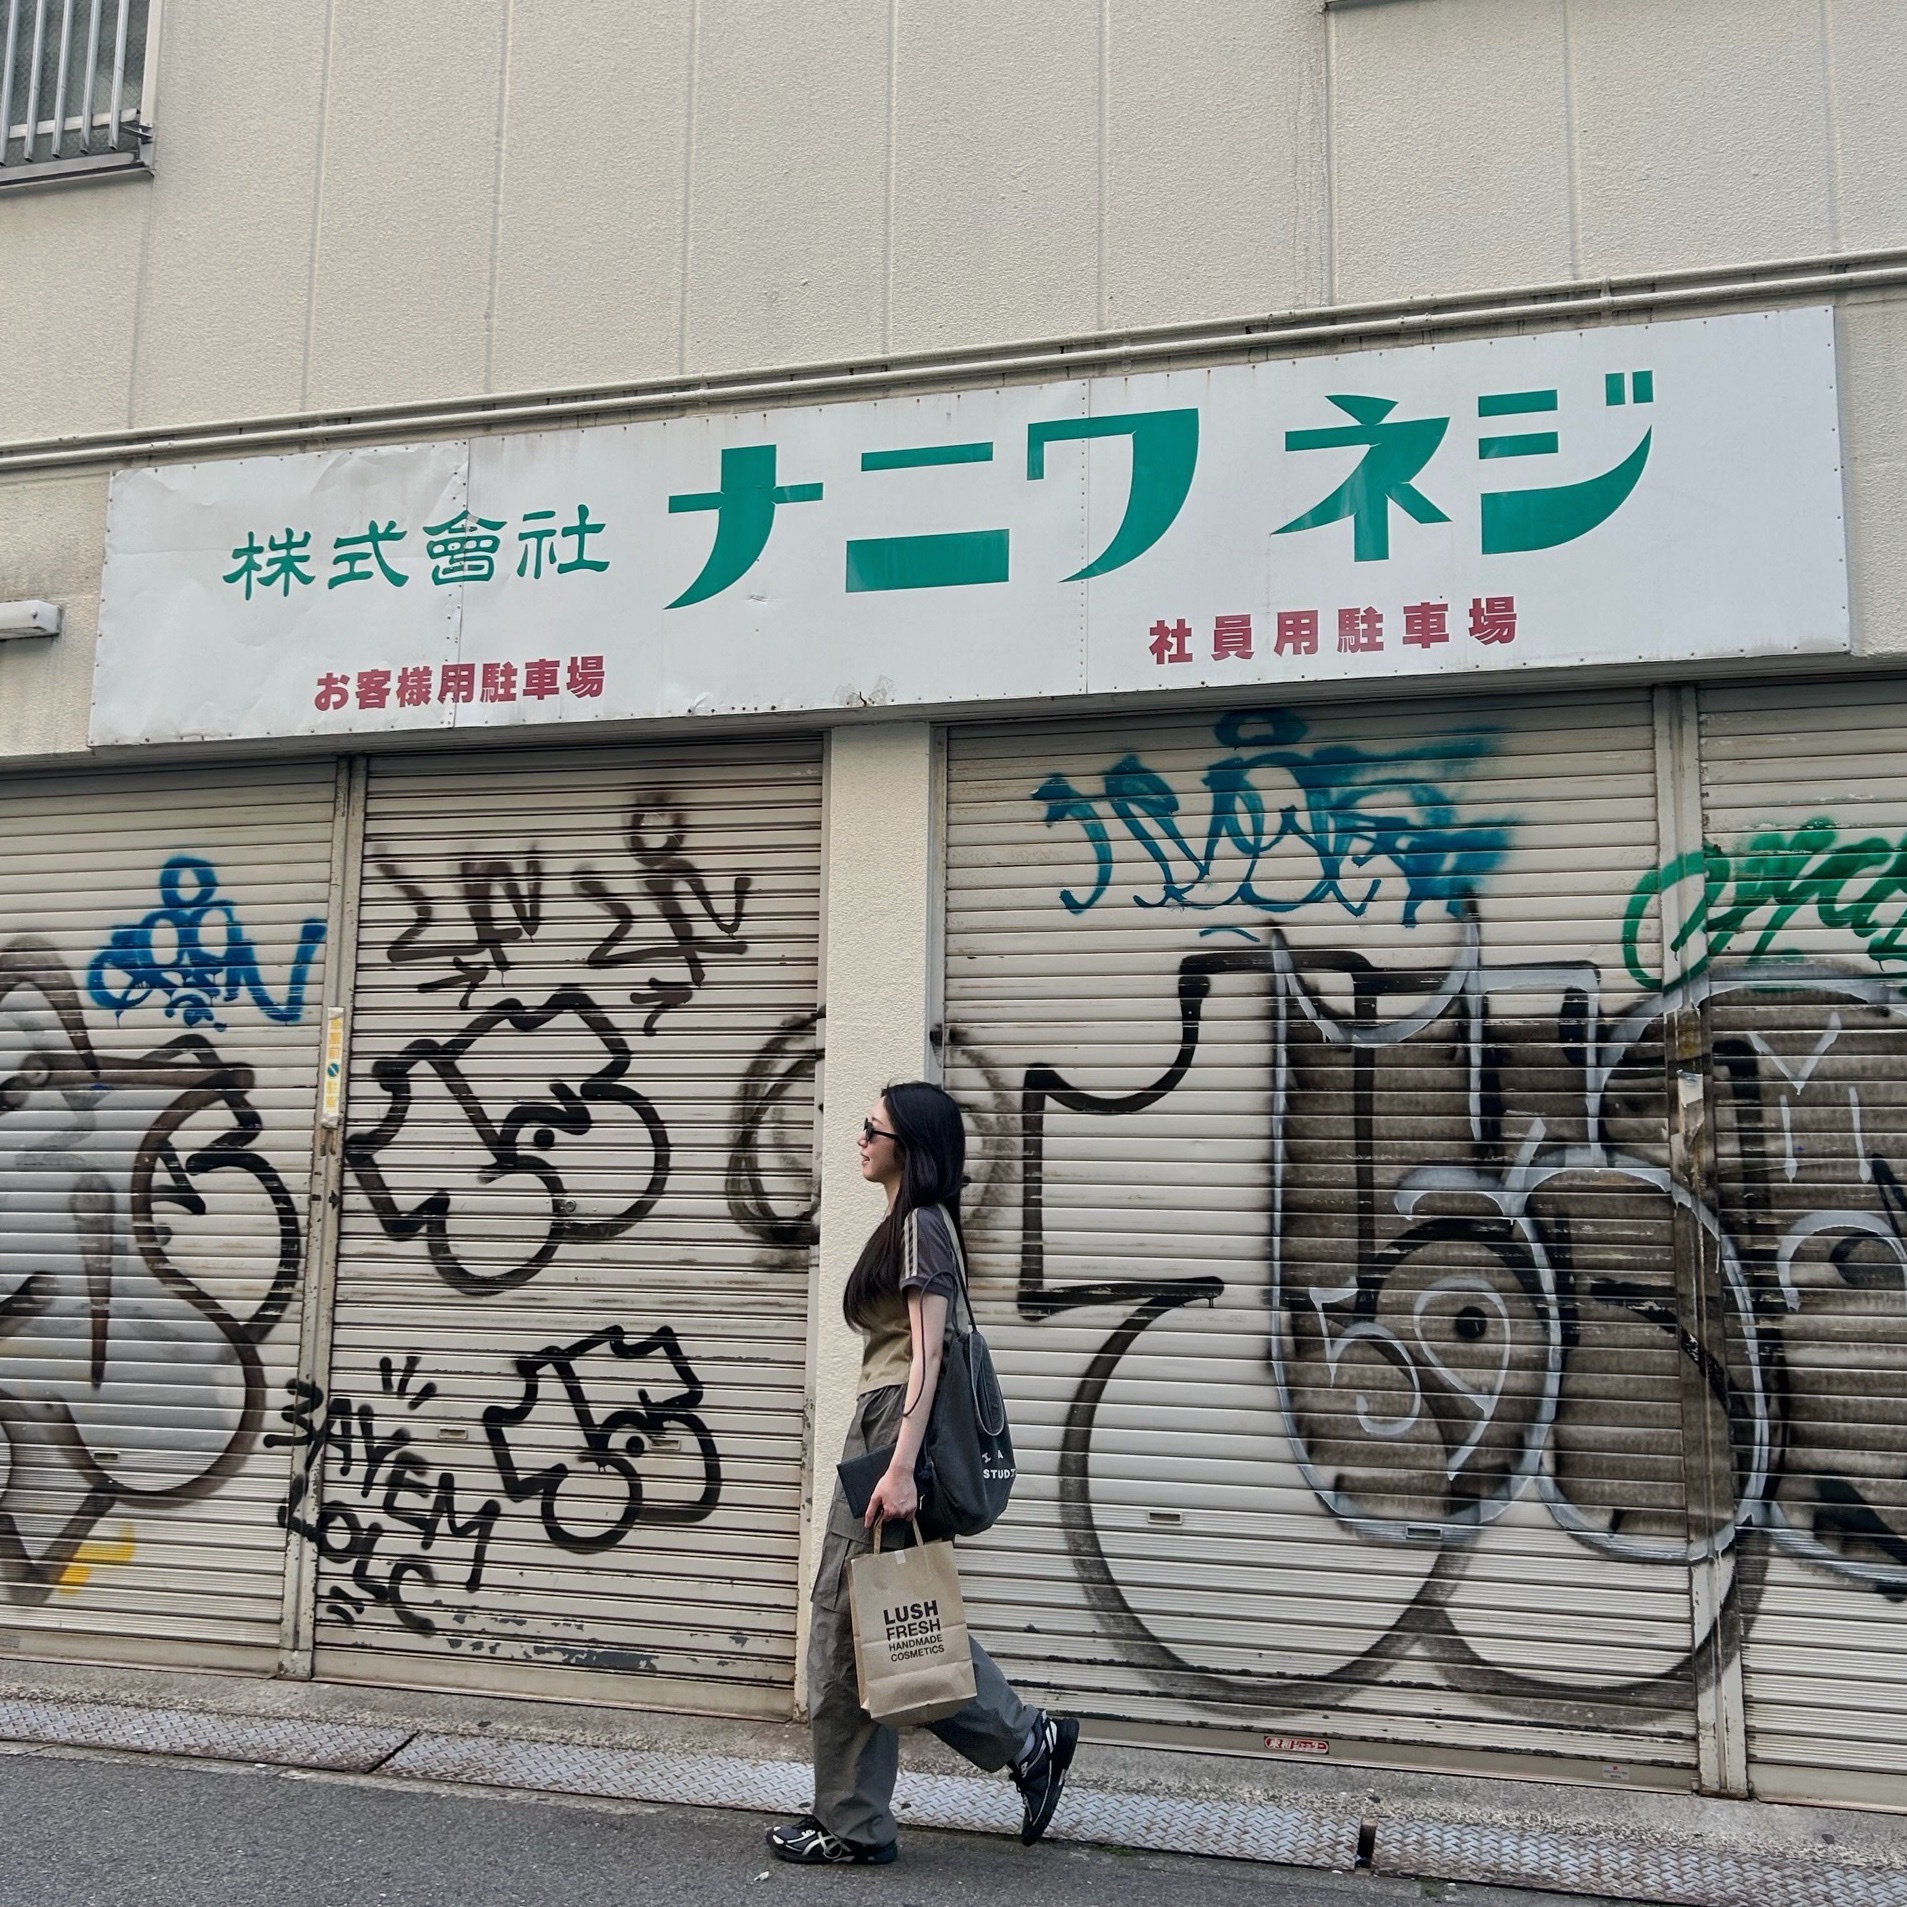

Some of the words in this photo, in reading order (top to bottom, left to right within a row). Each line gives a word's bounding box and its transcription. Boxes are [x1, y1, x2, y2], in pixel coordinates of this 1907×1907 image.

[222, 503, 611, 601] 株式會社
[1148, 595, 1517, 666] 社員用駐車場
[313, 655, 605, 712] お客様用駐車場
[883, 1600, 939, 1625] LUSH
[886, 1618, 941, 1641] FRESH
[888, 1634, 943, 1652] HANDMADE
[891, 1644, 945, 1662] COSMETICS
